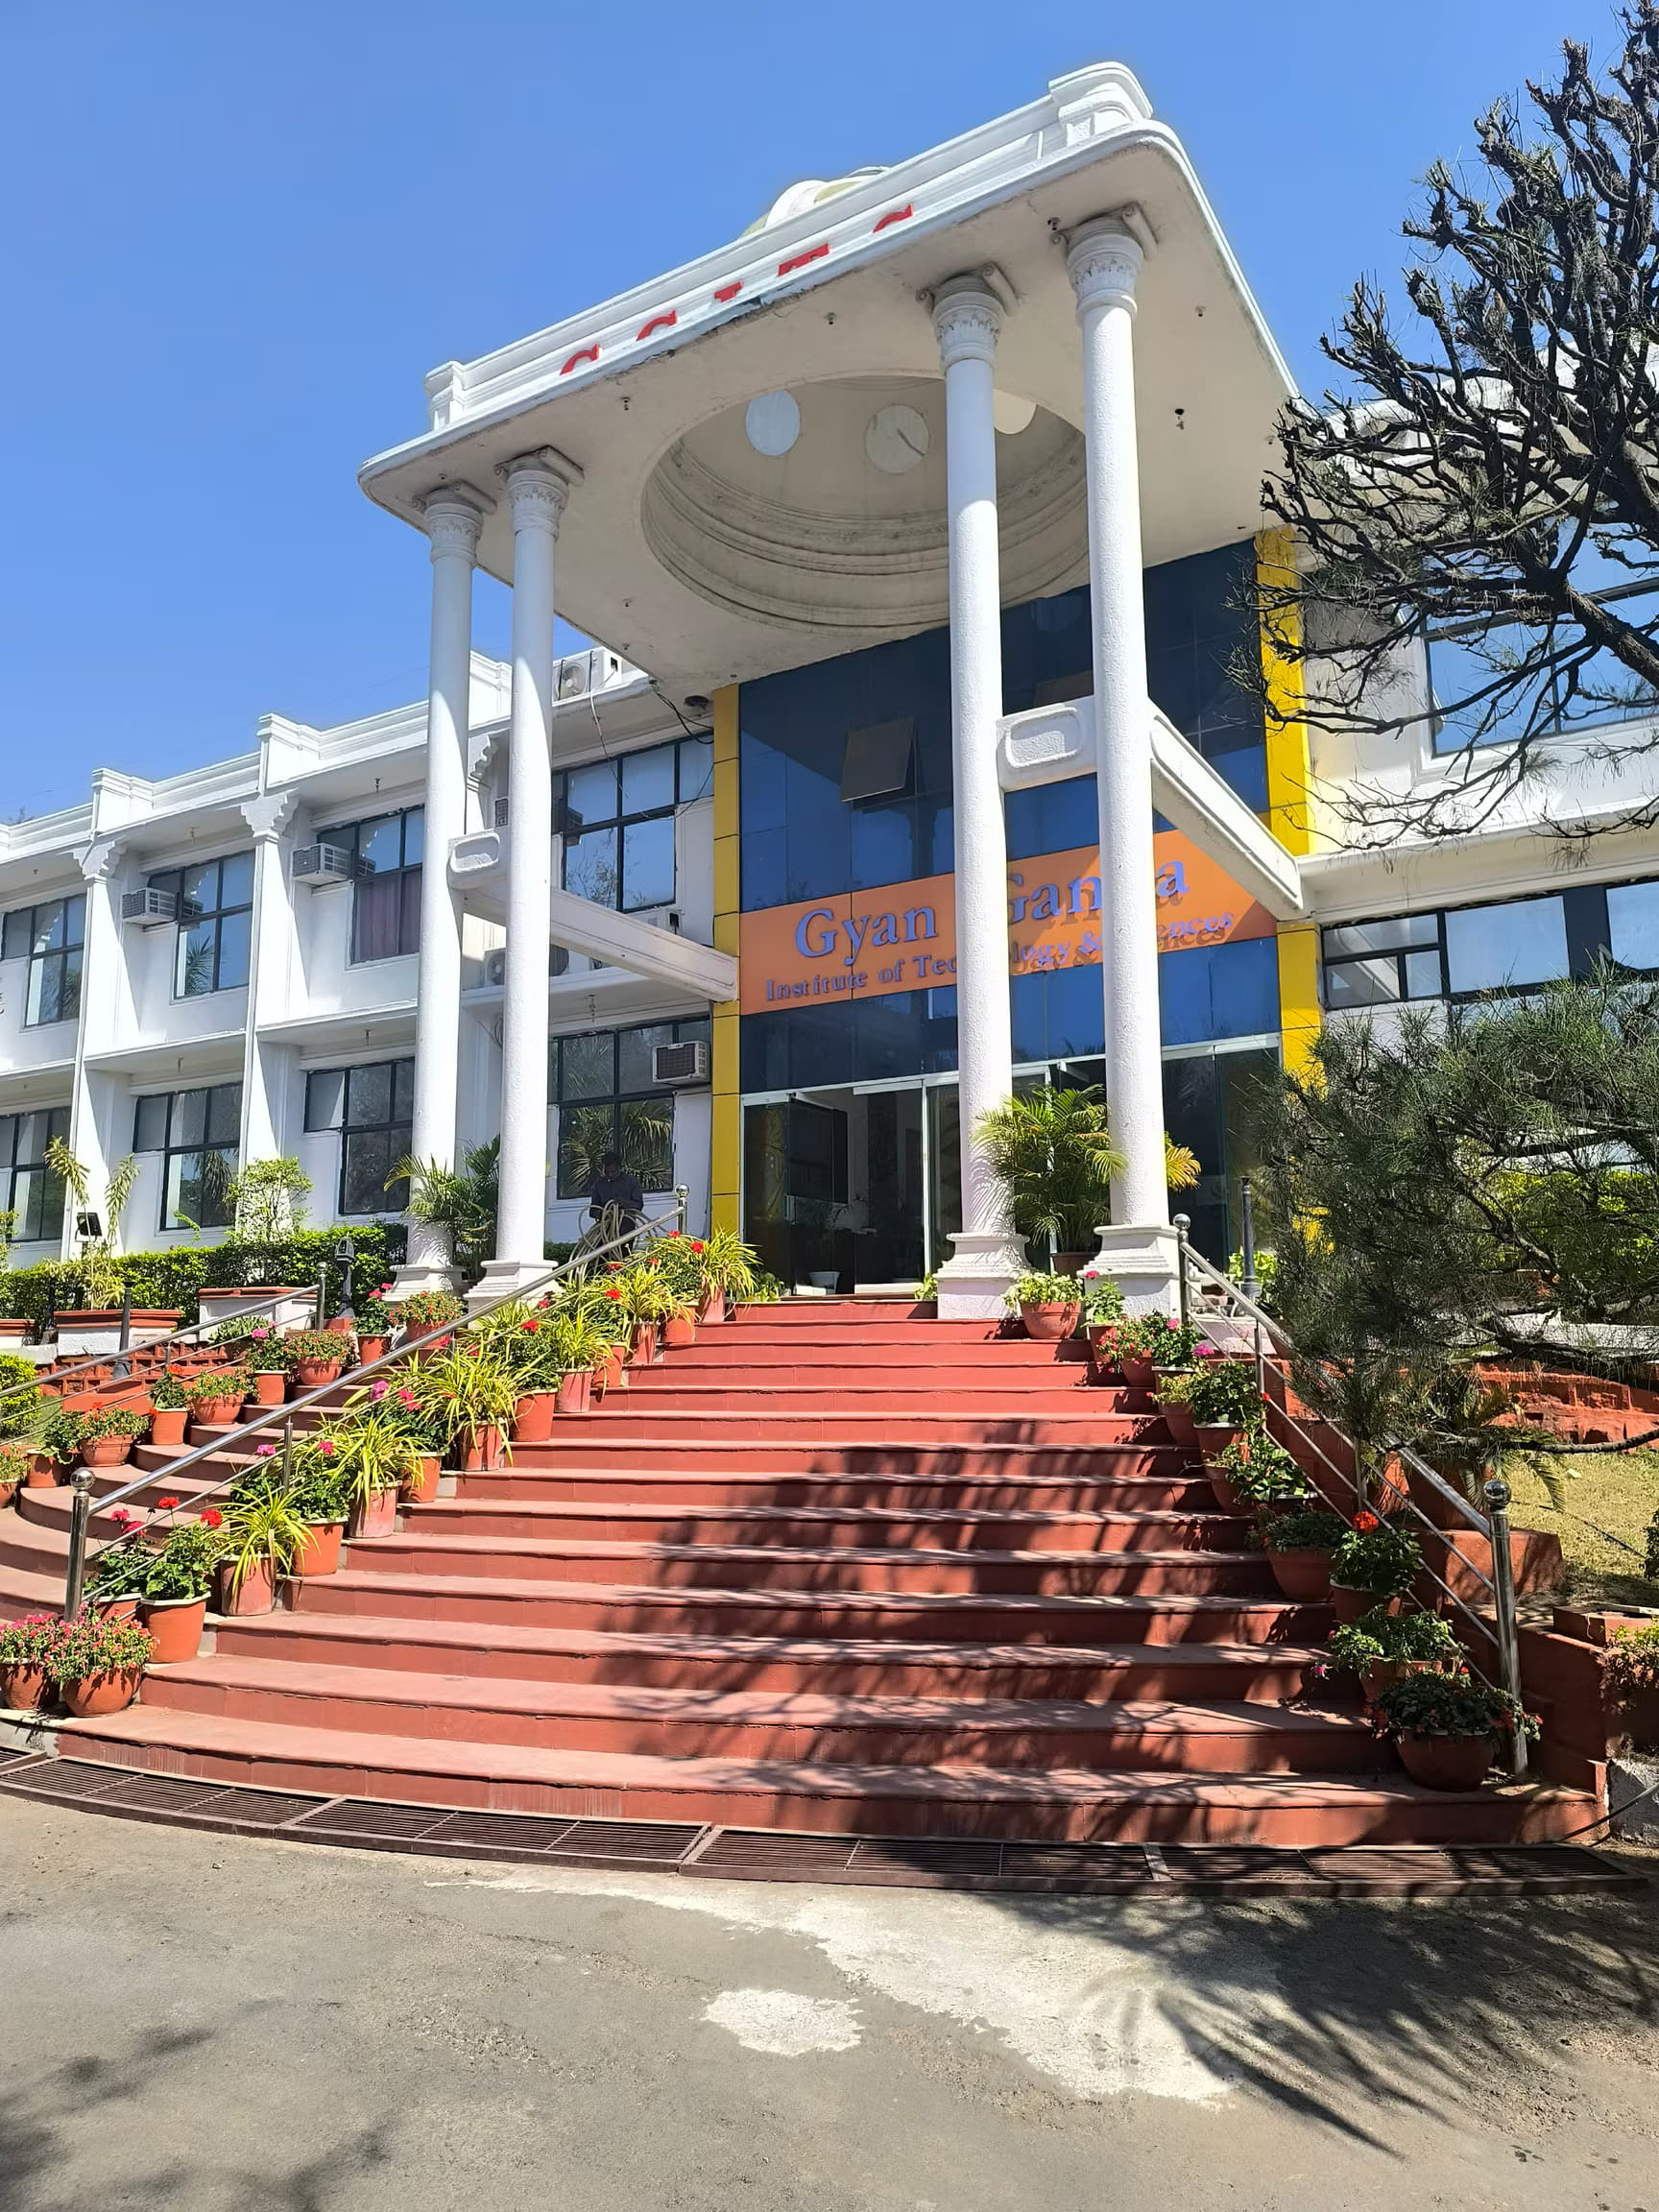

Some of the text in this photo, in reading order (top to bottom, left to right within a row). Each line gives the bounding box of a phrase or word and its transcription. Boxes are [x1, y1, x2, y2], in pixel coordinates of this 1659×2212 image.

[795, 861, 1190, 966] Gyan Gana
[766, 972, 868, 1001] Institute
[878, 959, 905, 983] of
[1078, 930, 1103, 954] &
